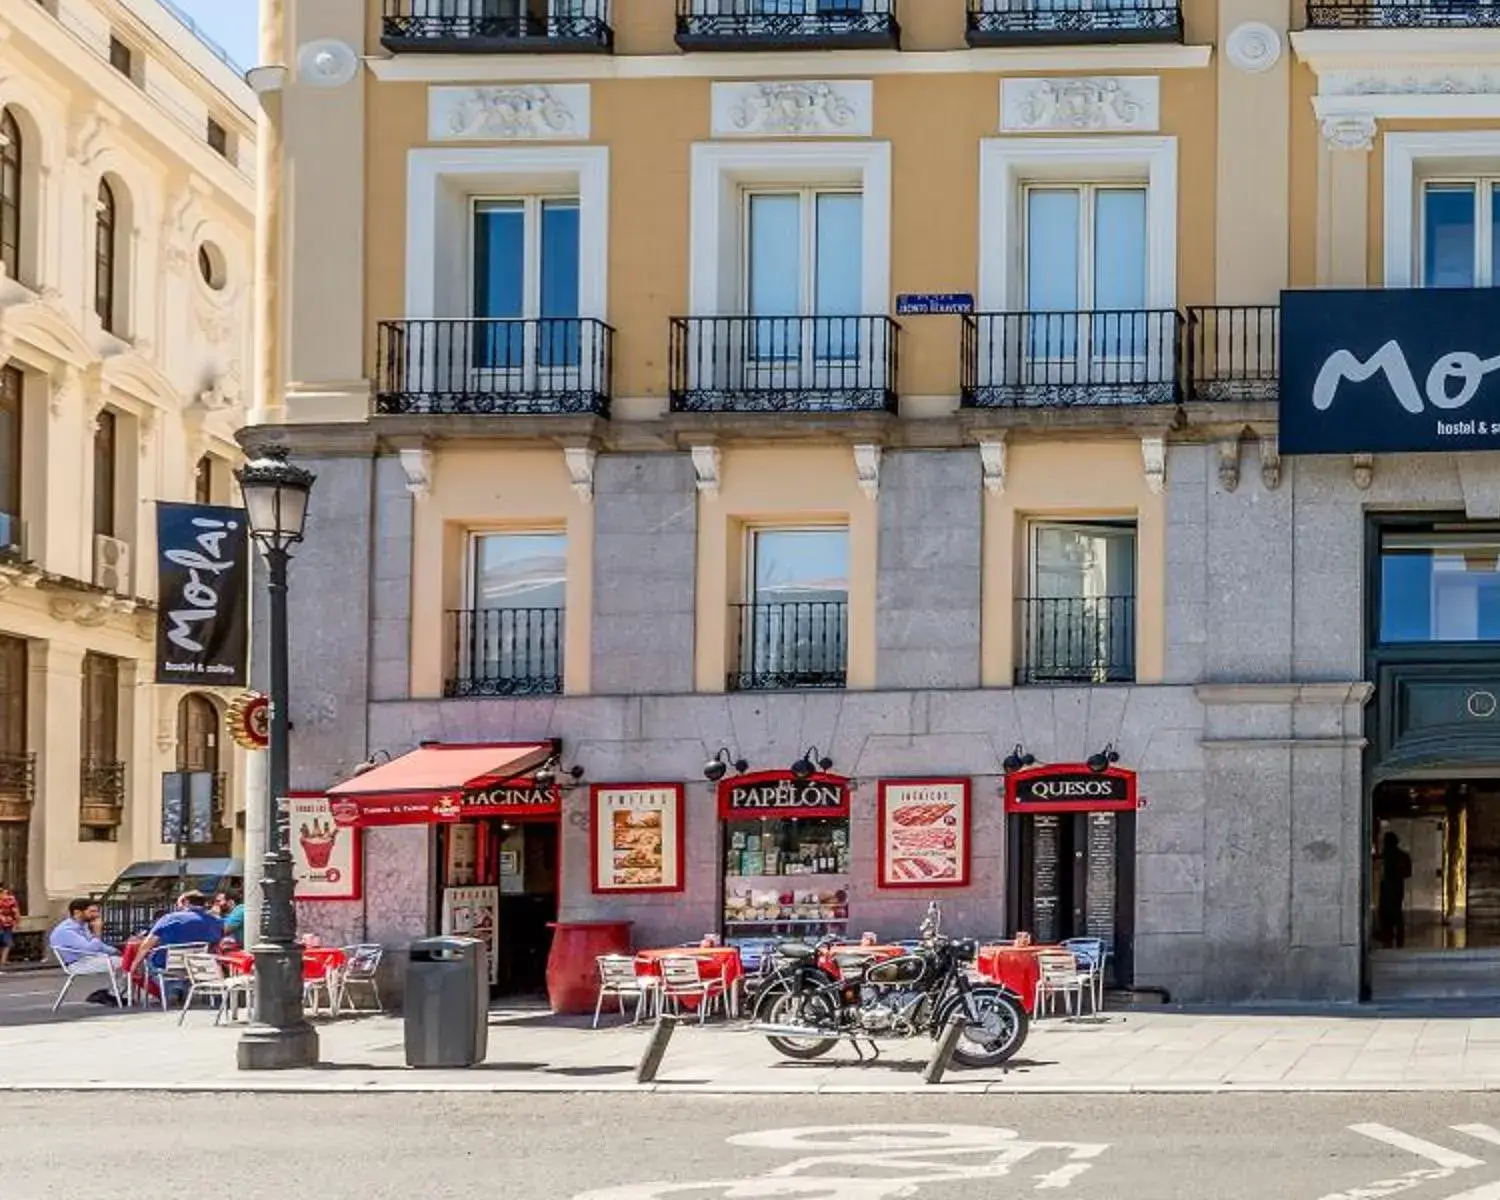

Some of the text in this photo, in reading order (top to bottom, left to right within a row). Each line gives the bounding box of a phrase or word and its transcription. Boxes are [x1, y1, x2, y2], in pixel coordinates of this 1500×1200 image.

[1437, 420, 1476, 435] hostel
[1478, 421, 1488, 435] &
[732, 781, 841, 807] PAPELÓN
[1031, 781, 1112, 799] QUESOS
